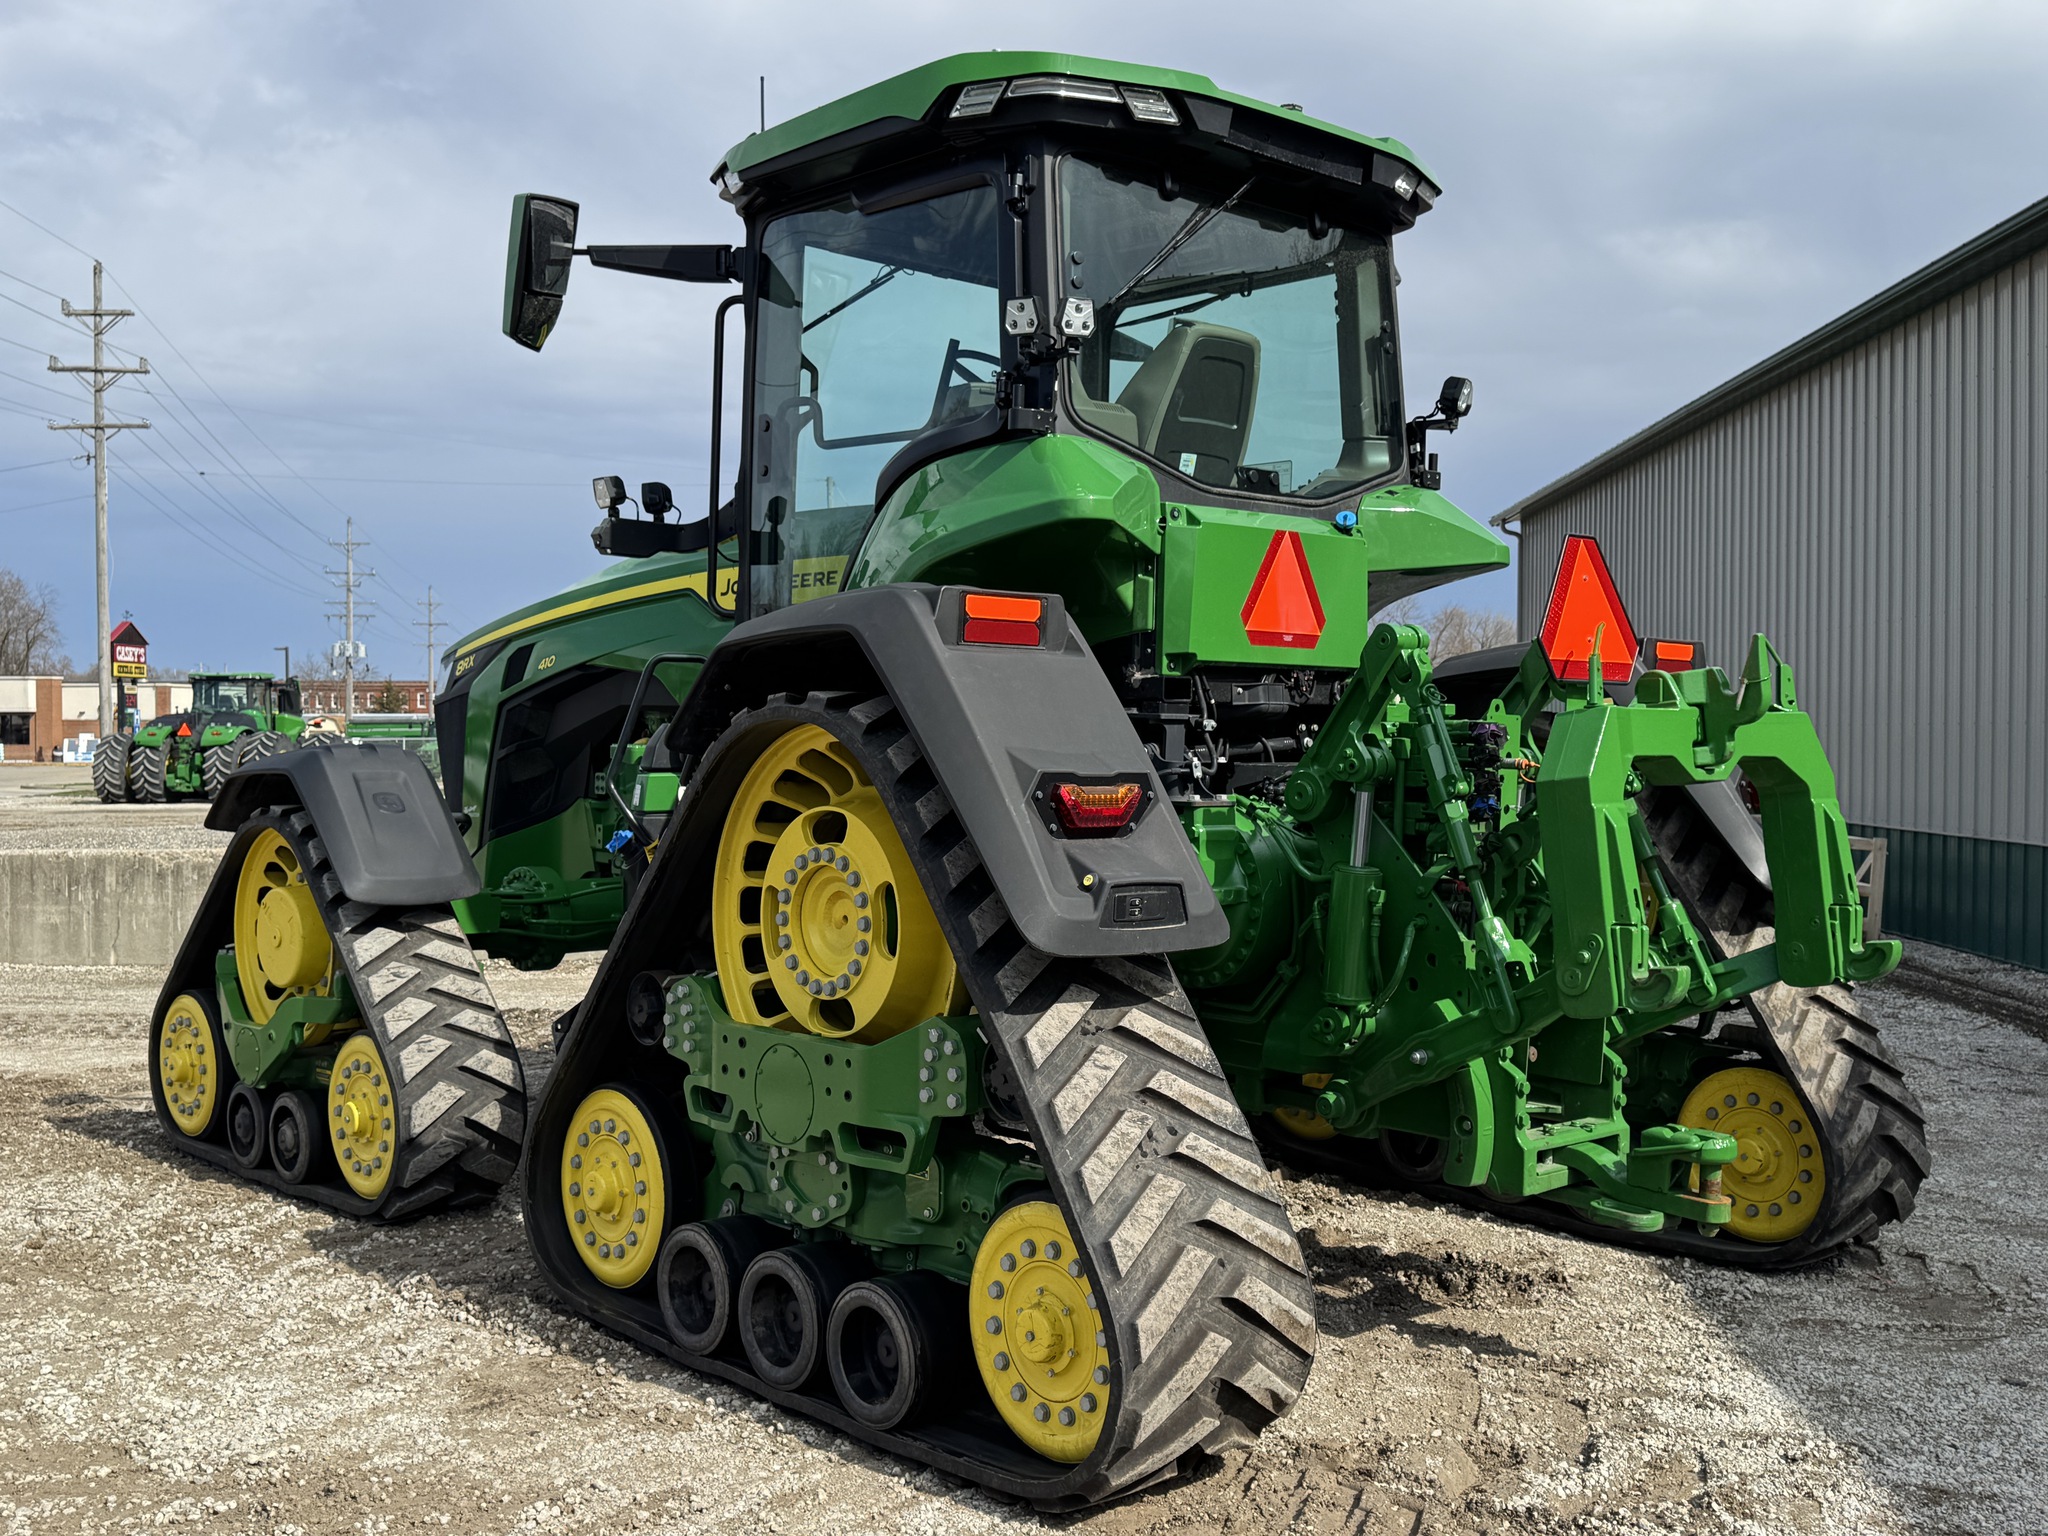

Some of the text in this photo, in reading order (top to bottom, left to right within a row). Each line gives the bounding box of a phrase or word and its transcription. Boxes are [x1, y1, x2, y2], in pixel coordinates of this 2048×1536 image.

[792, 570, 838, 588] EERE
[116, 645, 145, 663] CASEY'S
[538, 655, 556, 670] 410
[456, 655, 476, 676] 8RX
